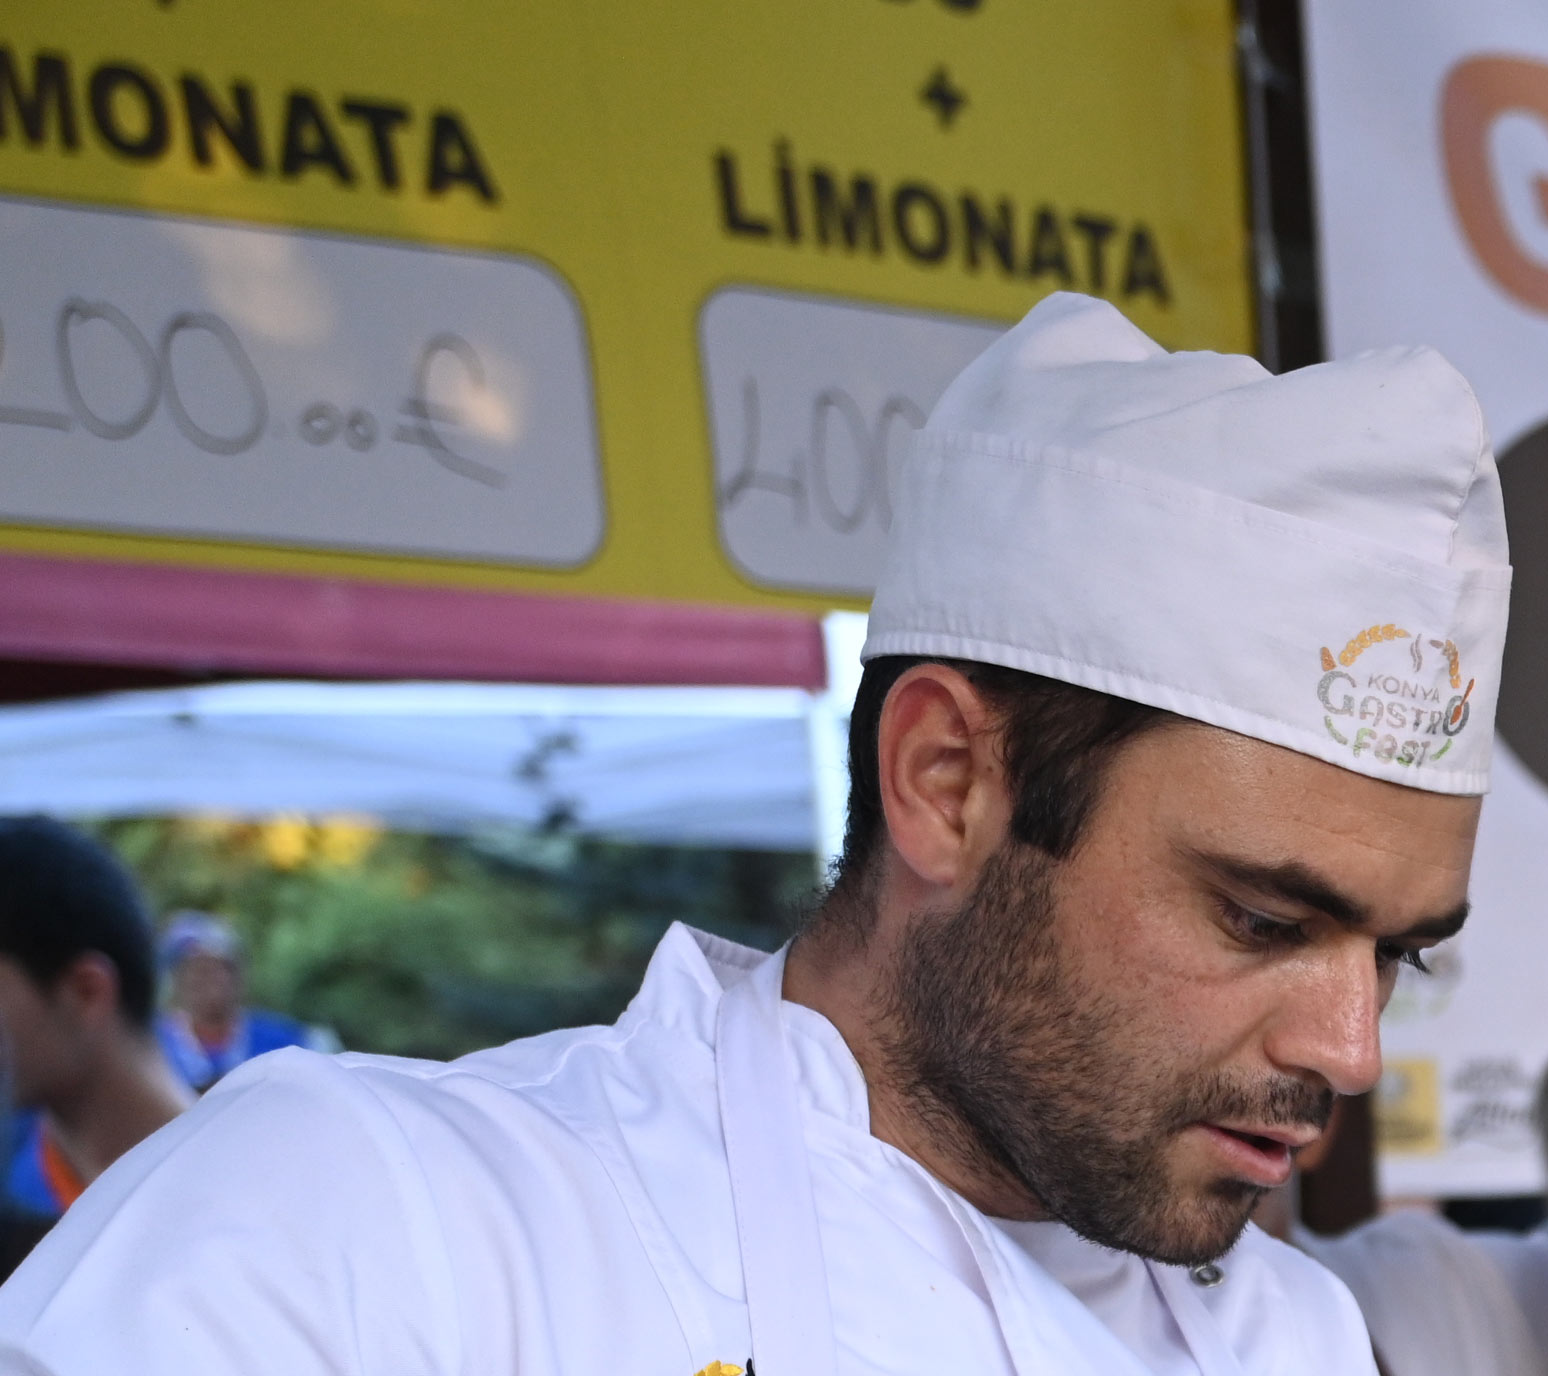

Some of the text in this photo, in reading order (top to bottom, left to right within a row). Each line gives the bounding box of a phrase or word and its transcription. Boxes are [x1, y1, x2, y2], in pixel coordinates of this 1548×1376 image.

[714, 138, 1174, 309] LİMONATA
[1317, 669, 1472, 737] GASTRO
[1367, 672, 1441, 704] KONYA
